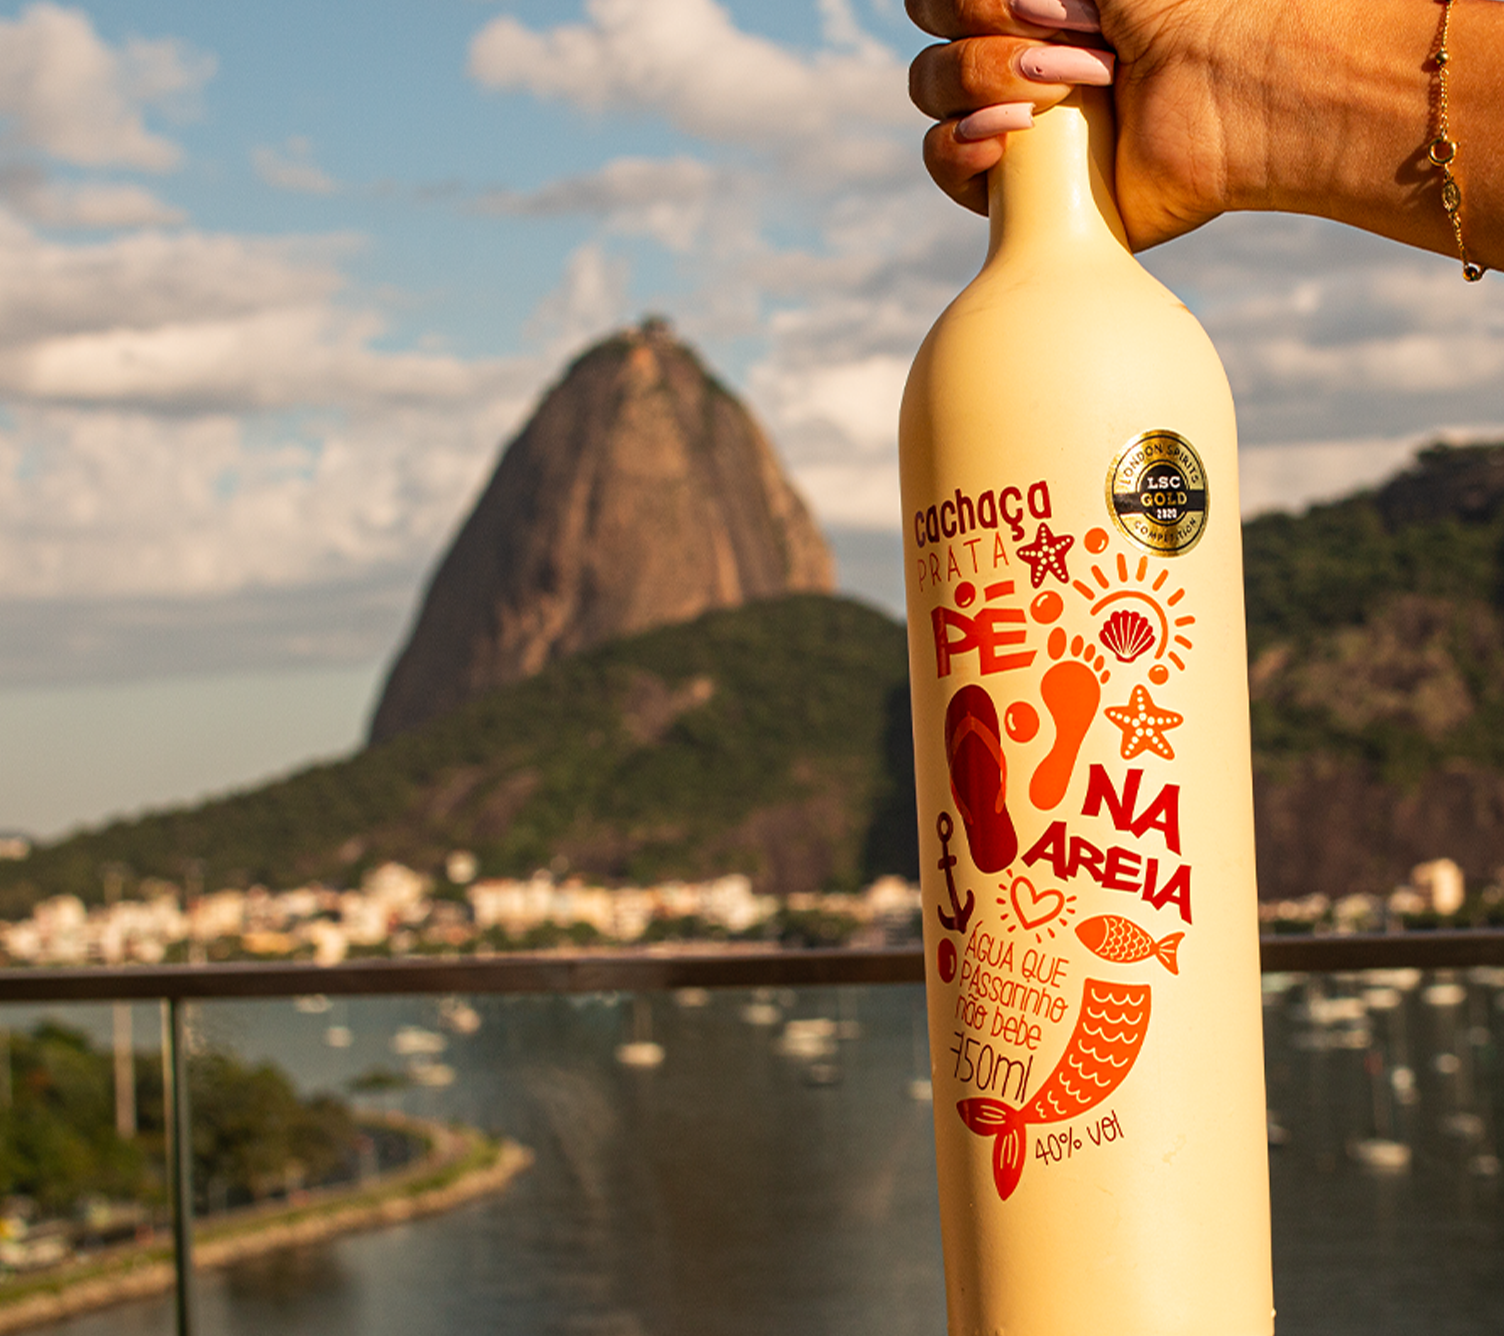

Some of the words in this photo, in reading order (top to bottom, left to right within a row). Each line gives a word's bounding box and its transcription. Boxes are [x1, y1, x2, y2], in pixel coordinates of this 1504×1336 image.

[1120, 443, 1163, 486] LONDON
[1166, 444, 1199, 484] SPIRITS
[1147, 476, 1180, 489] LSC
[914, 480, 1052, 548] cachaça
[1134, 517, 1196, 542] COMPETITION
[1141, 491, 1187, 507] GOLD
[916, 531, 1010, 592] PRATA
[930, 580, 1038, 679] PÉ
[1081, 764, 1182, 856] NA
[1020, 821, 1193, 925] AREIA
[964, 920, 1021, 972] ÁGUA
[1022, 948, 1070, 989] QUE
[954, 992, 987, 1031] não
[990, 1008, 1042, 1051] bebe
[949, 1030, 1034, 1103] 750ml
[1035, 1127, 1082, 1165] 40%
[1086, 1109, 1125, 1147] vol
